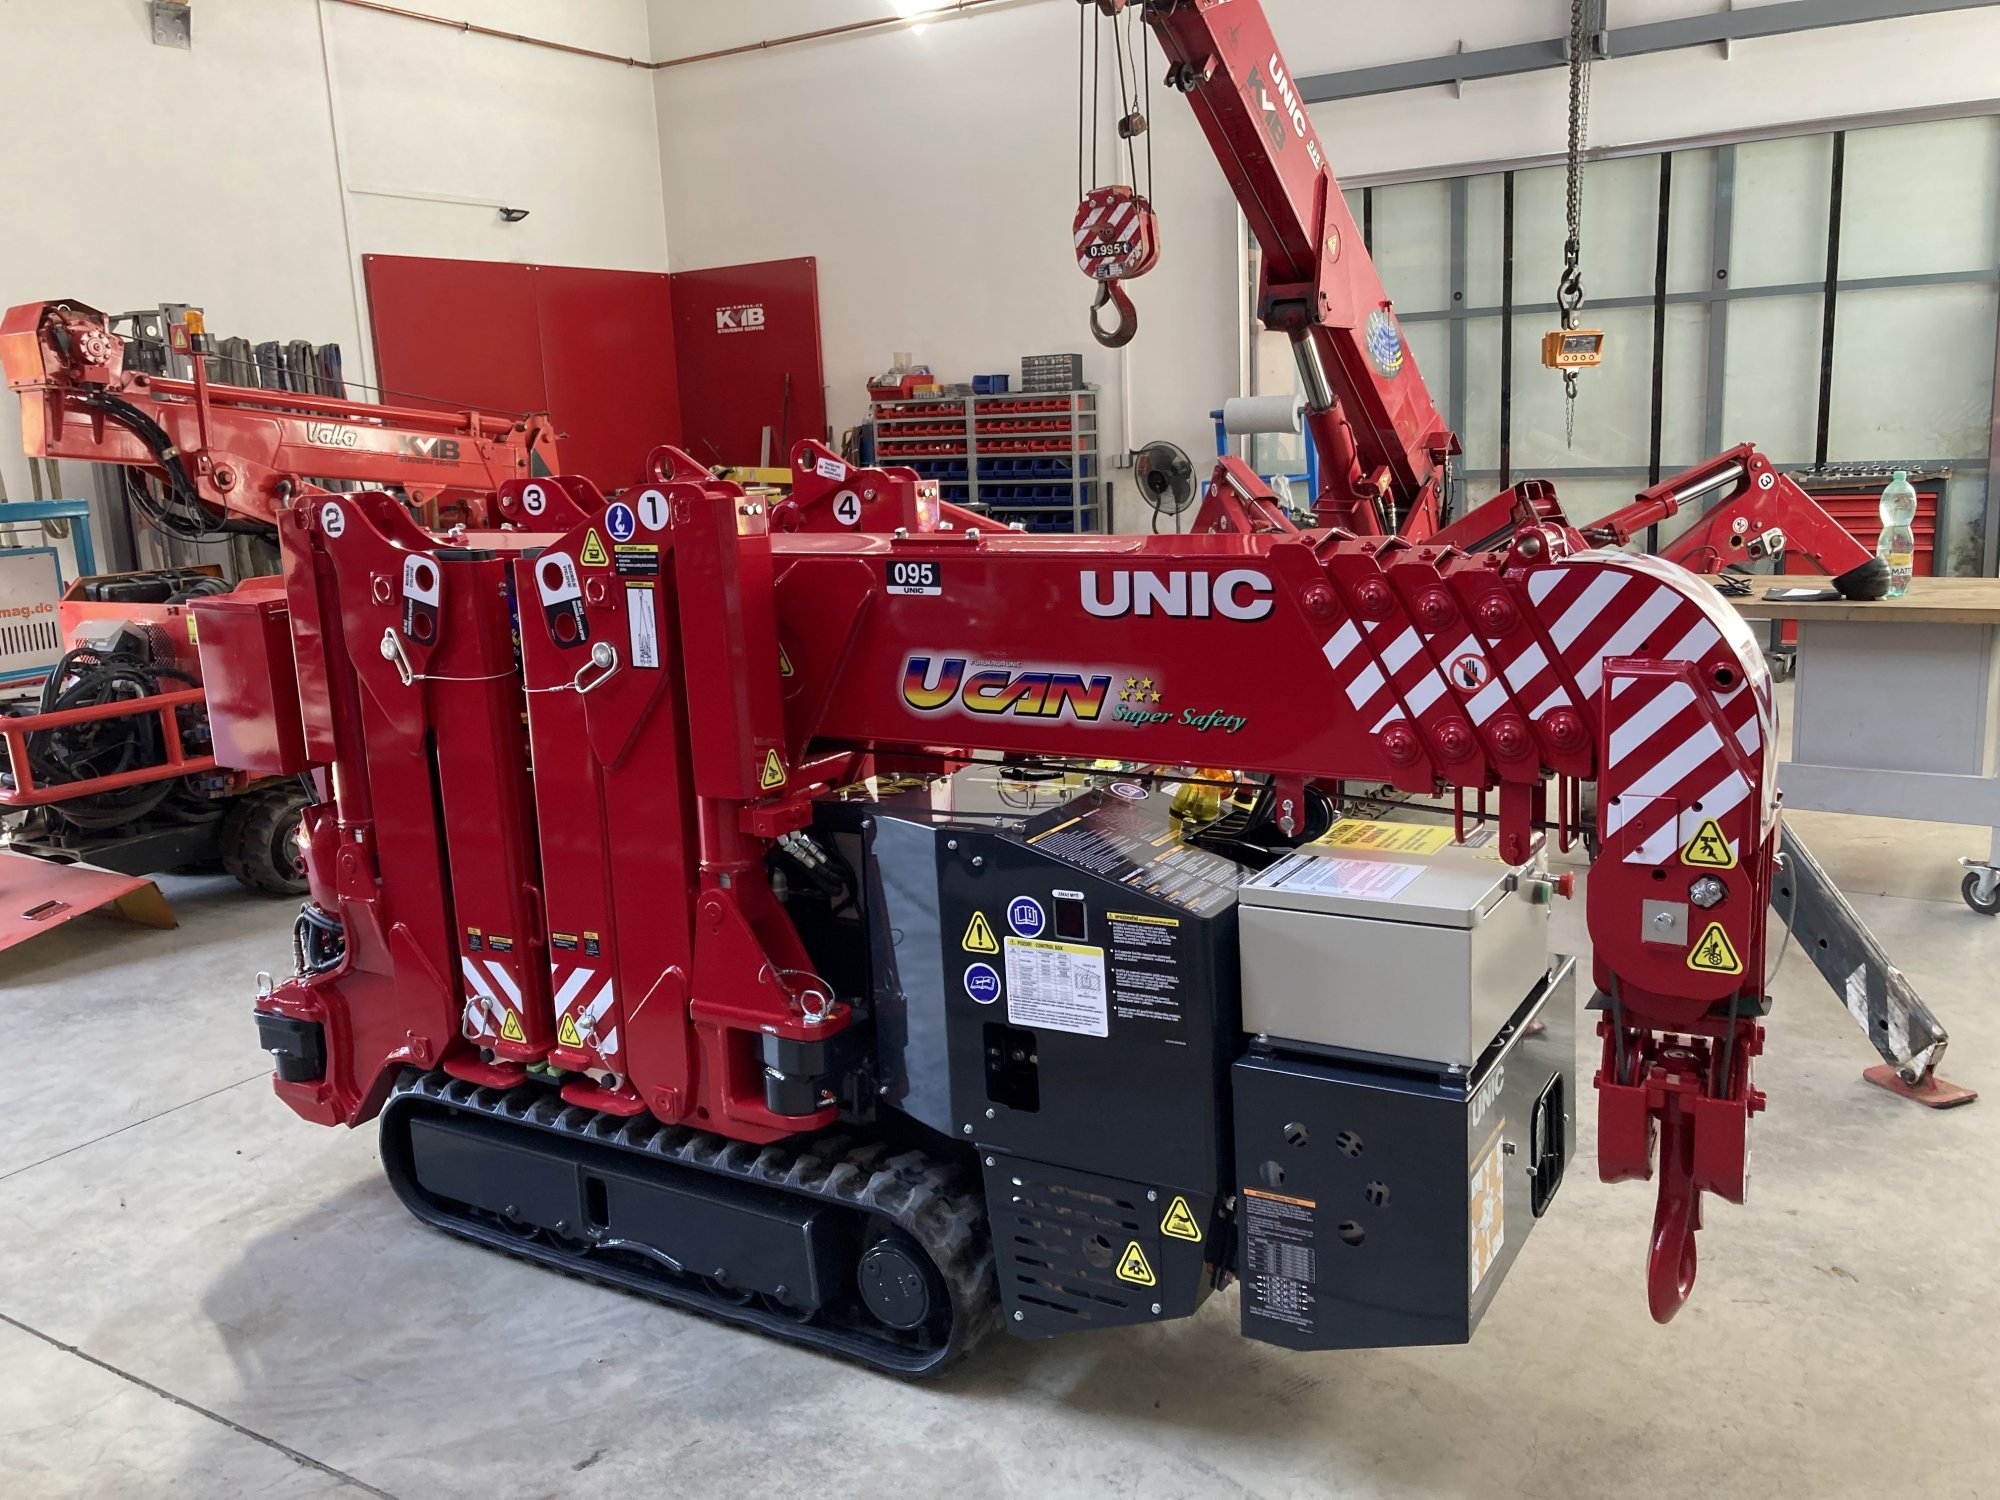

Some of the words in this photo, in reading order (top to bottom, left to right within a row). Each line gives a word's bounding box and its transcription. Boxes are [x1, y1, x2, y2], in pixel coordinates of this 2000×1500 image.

[1269, 52, 1306, 138] UNIC
[716, 307, 765, 329] KMB
[1760, 475, 1772, 487] 3
[527, 489, 542, 511] 3
[646, 496, 658, 525] 1
[838, 495, 857, 520] 4
[325, 507, 342, 533] 2
[893, 562, 934, 586] 095
[1080, 569, 1274, 620] UNIC
[1111, 703, 1173, 725] Super
[1177, 708, 1247, 733] Safety
[1472, 1065, 1505, 1127] UNIC
